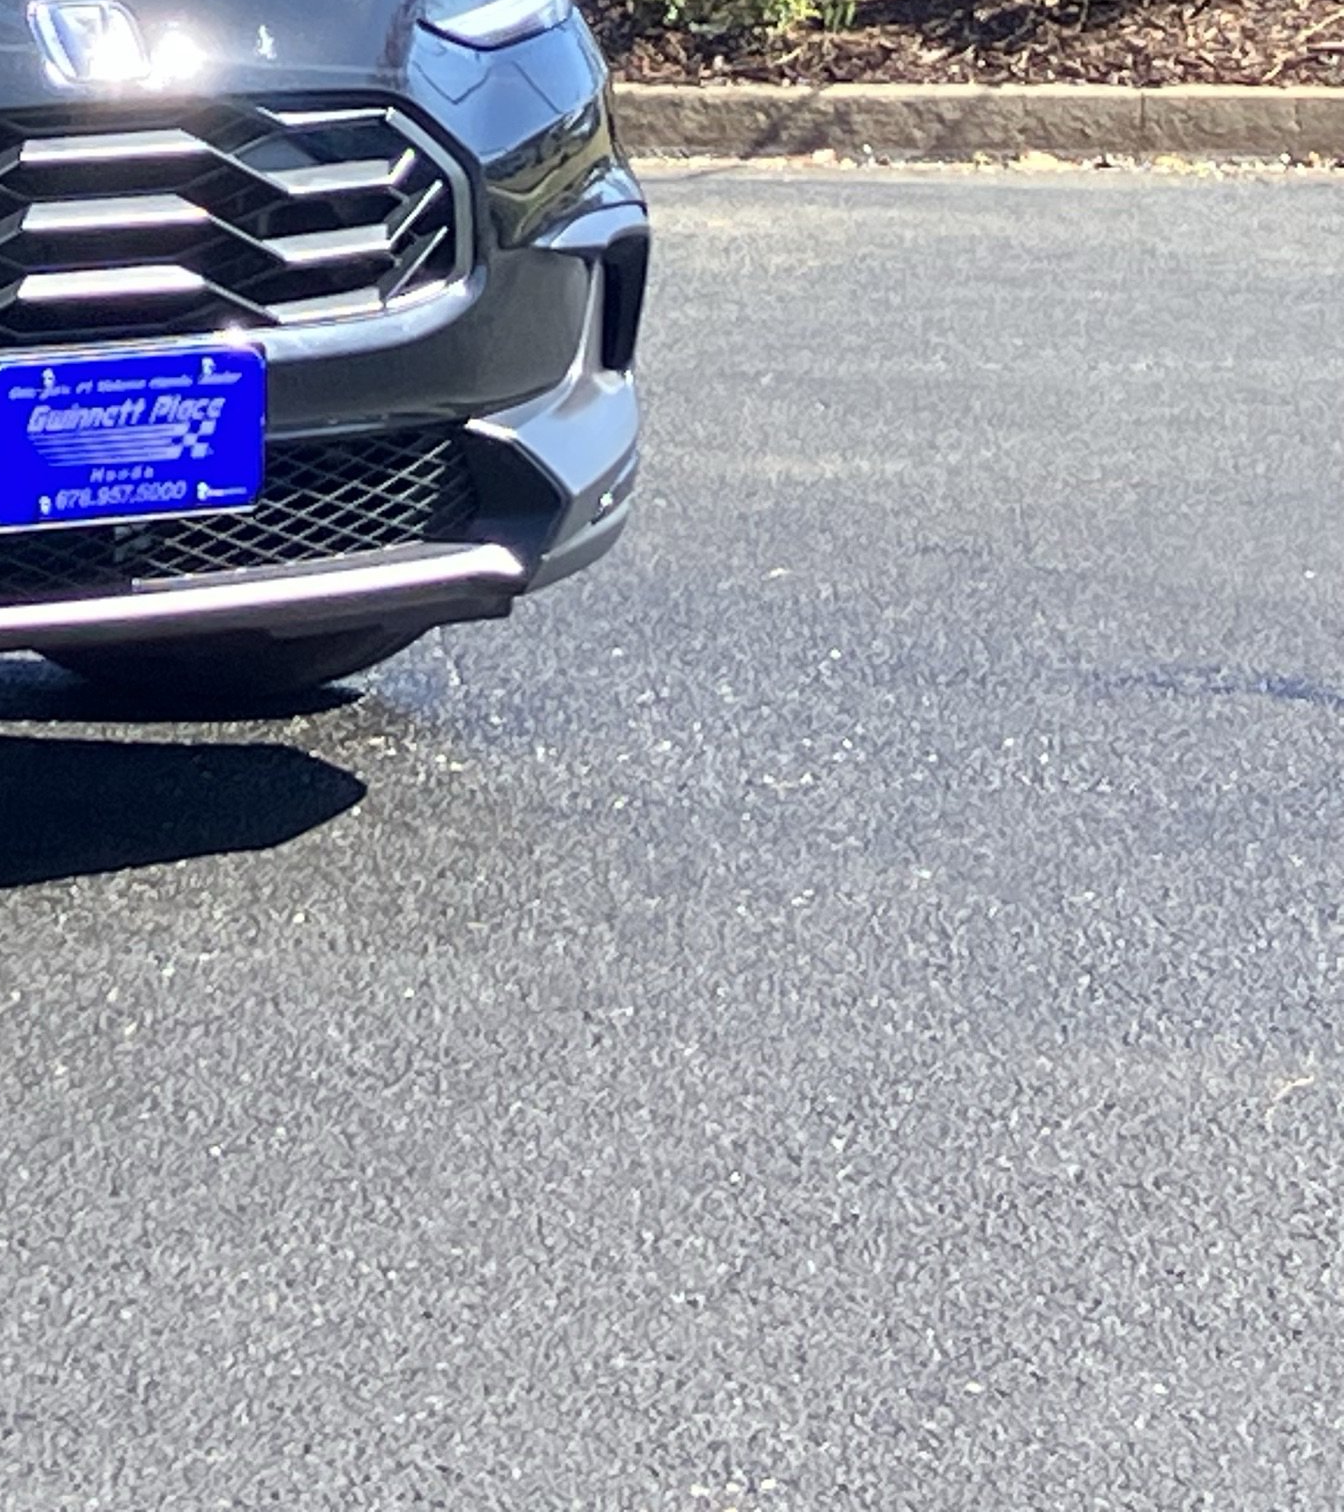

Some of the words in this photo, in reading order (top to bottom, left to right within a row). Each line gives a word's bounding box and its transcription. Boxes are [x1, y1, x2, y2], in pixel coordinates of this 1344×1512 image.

[27, 397, 146, 433] Gwinnett
[149, 394, 226, 424] Place
[90, 466, 154, 482] Honda
